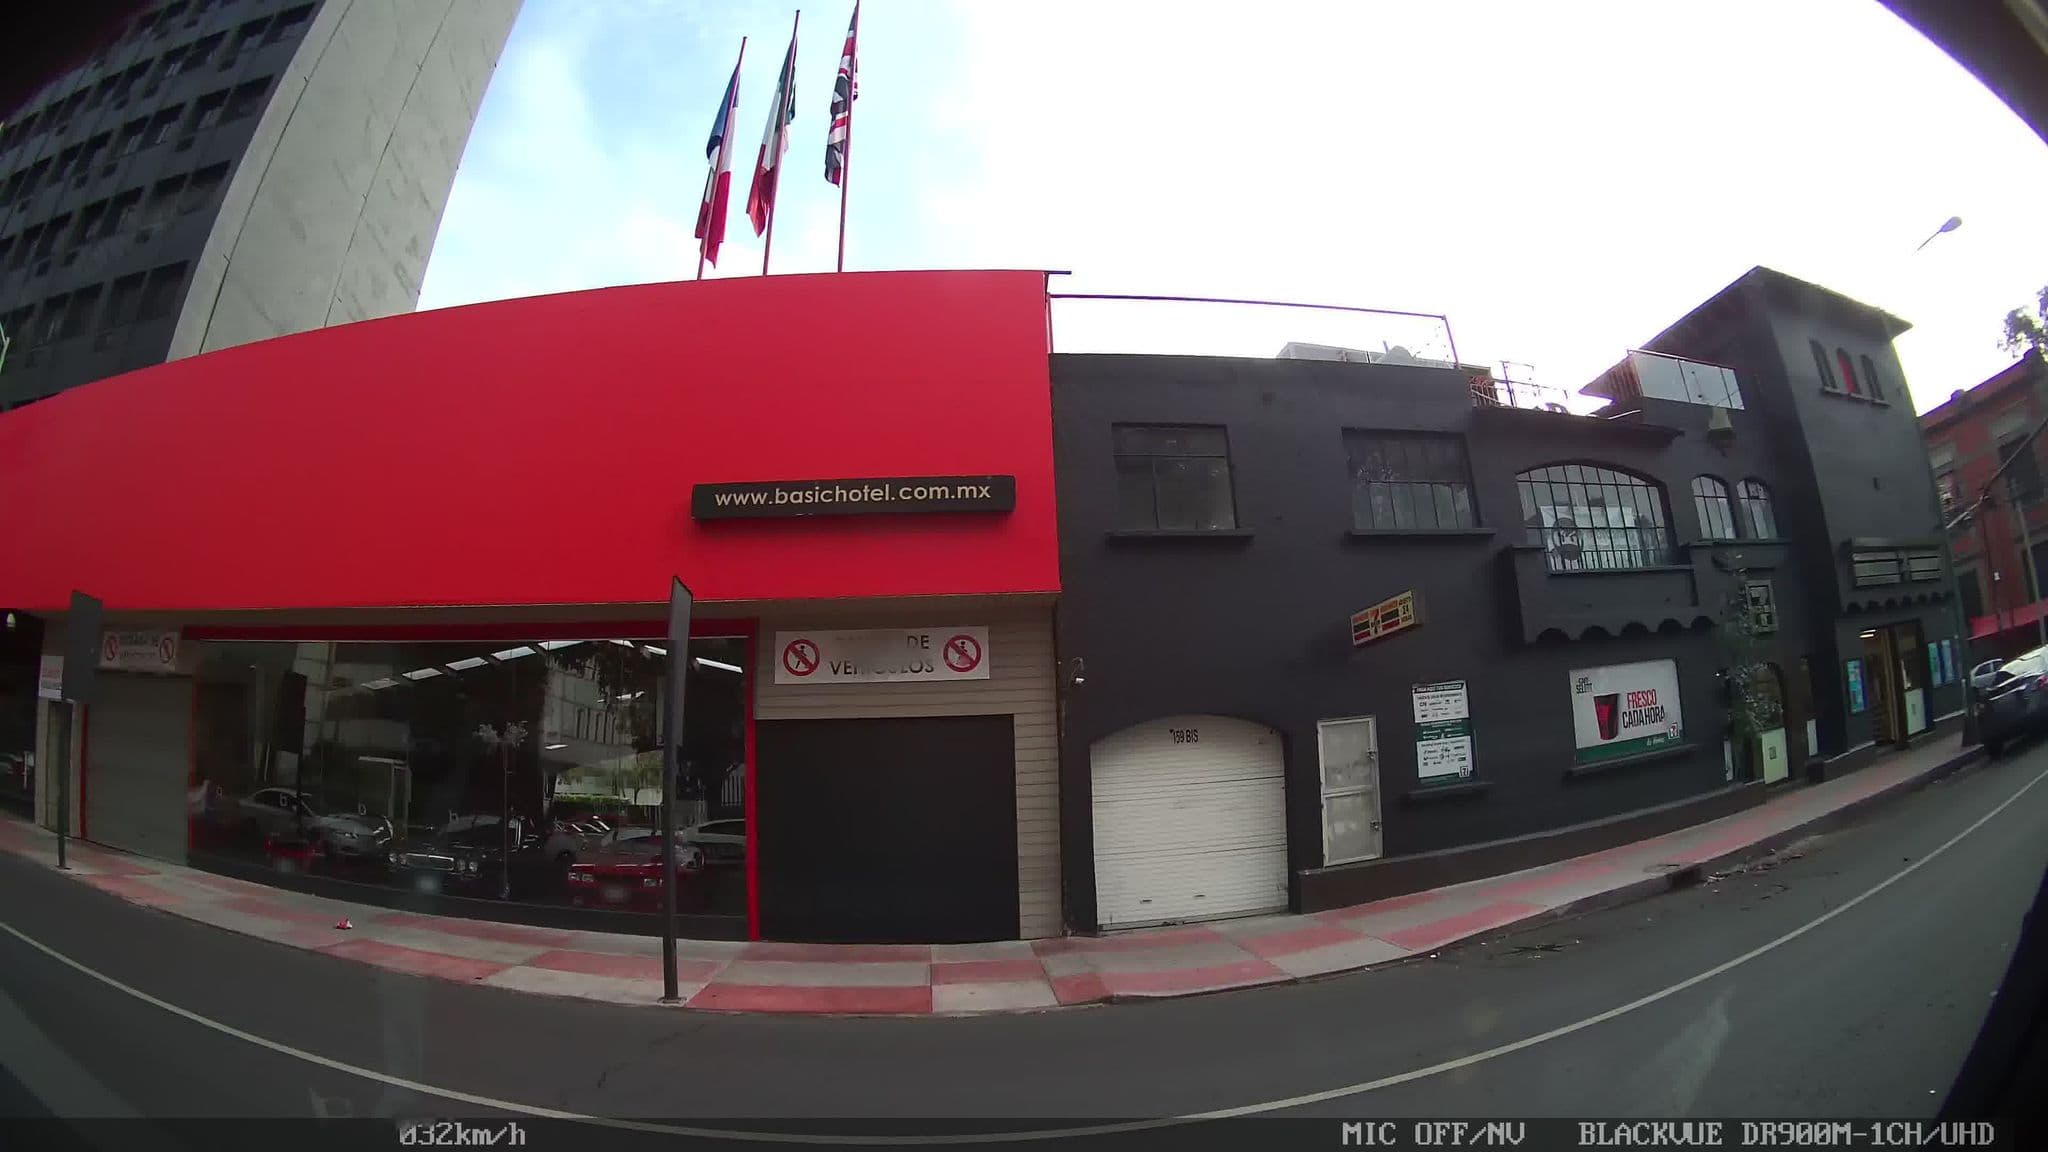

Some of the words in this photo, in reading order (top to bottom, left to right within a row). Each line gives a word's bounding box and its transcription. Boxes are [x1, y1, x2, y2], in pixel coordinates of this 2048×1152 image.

[714, 483, 991, 508] www.basichotel.com.mx
[906, 634, 930, 649] DE
[829, 656, 935, 675] VELOS
[1627, 689, 1657, 709] FRESCO
[1622, 708, 1645, 729] CADA
[1643, 704, 1666, 725] HORA
[1185, 729, 1198, 743] BIS
